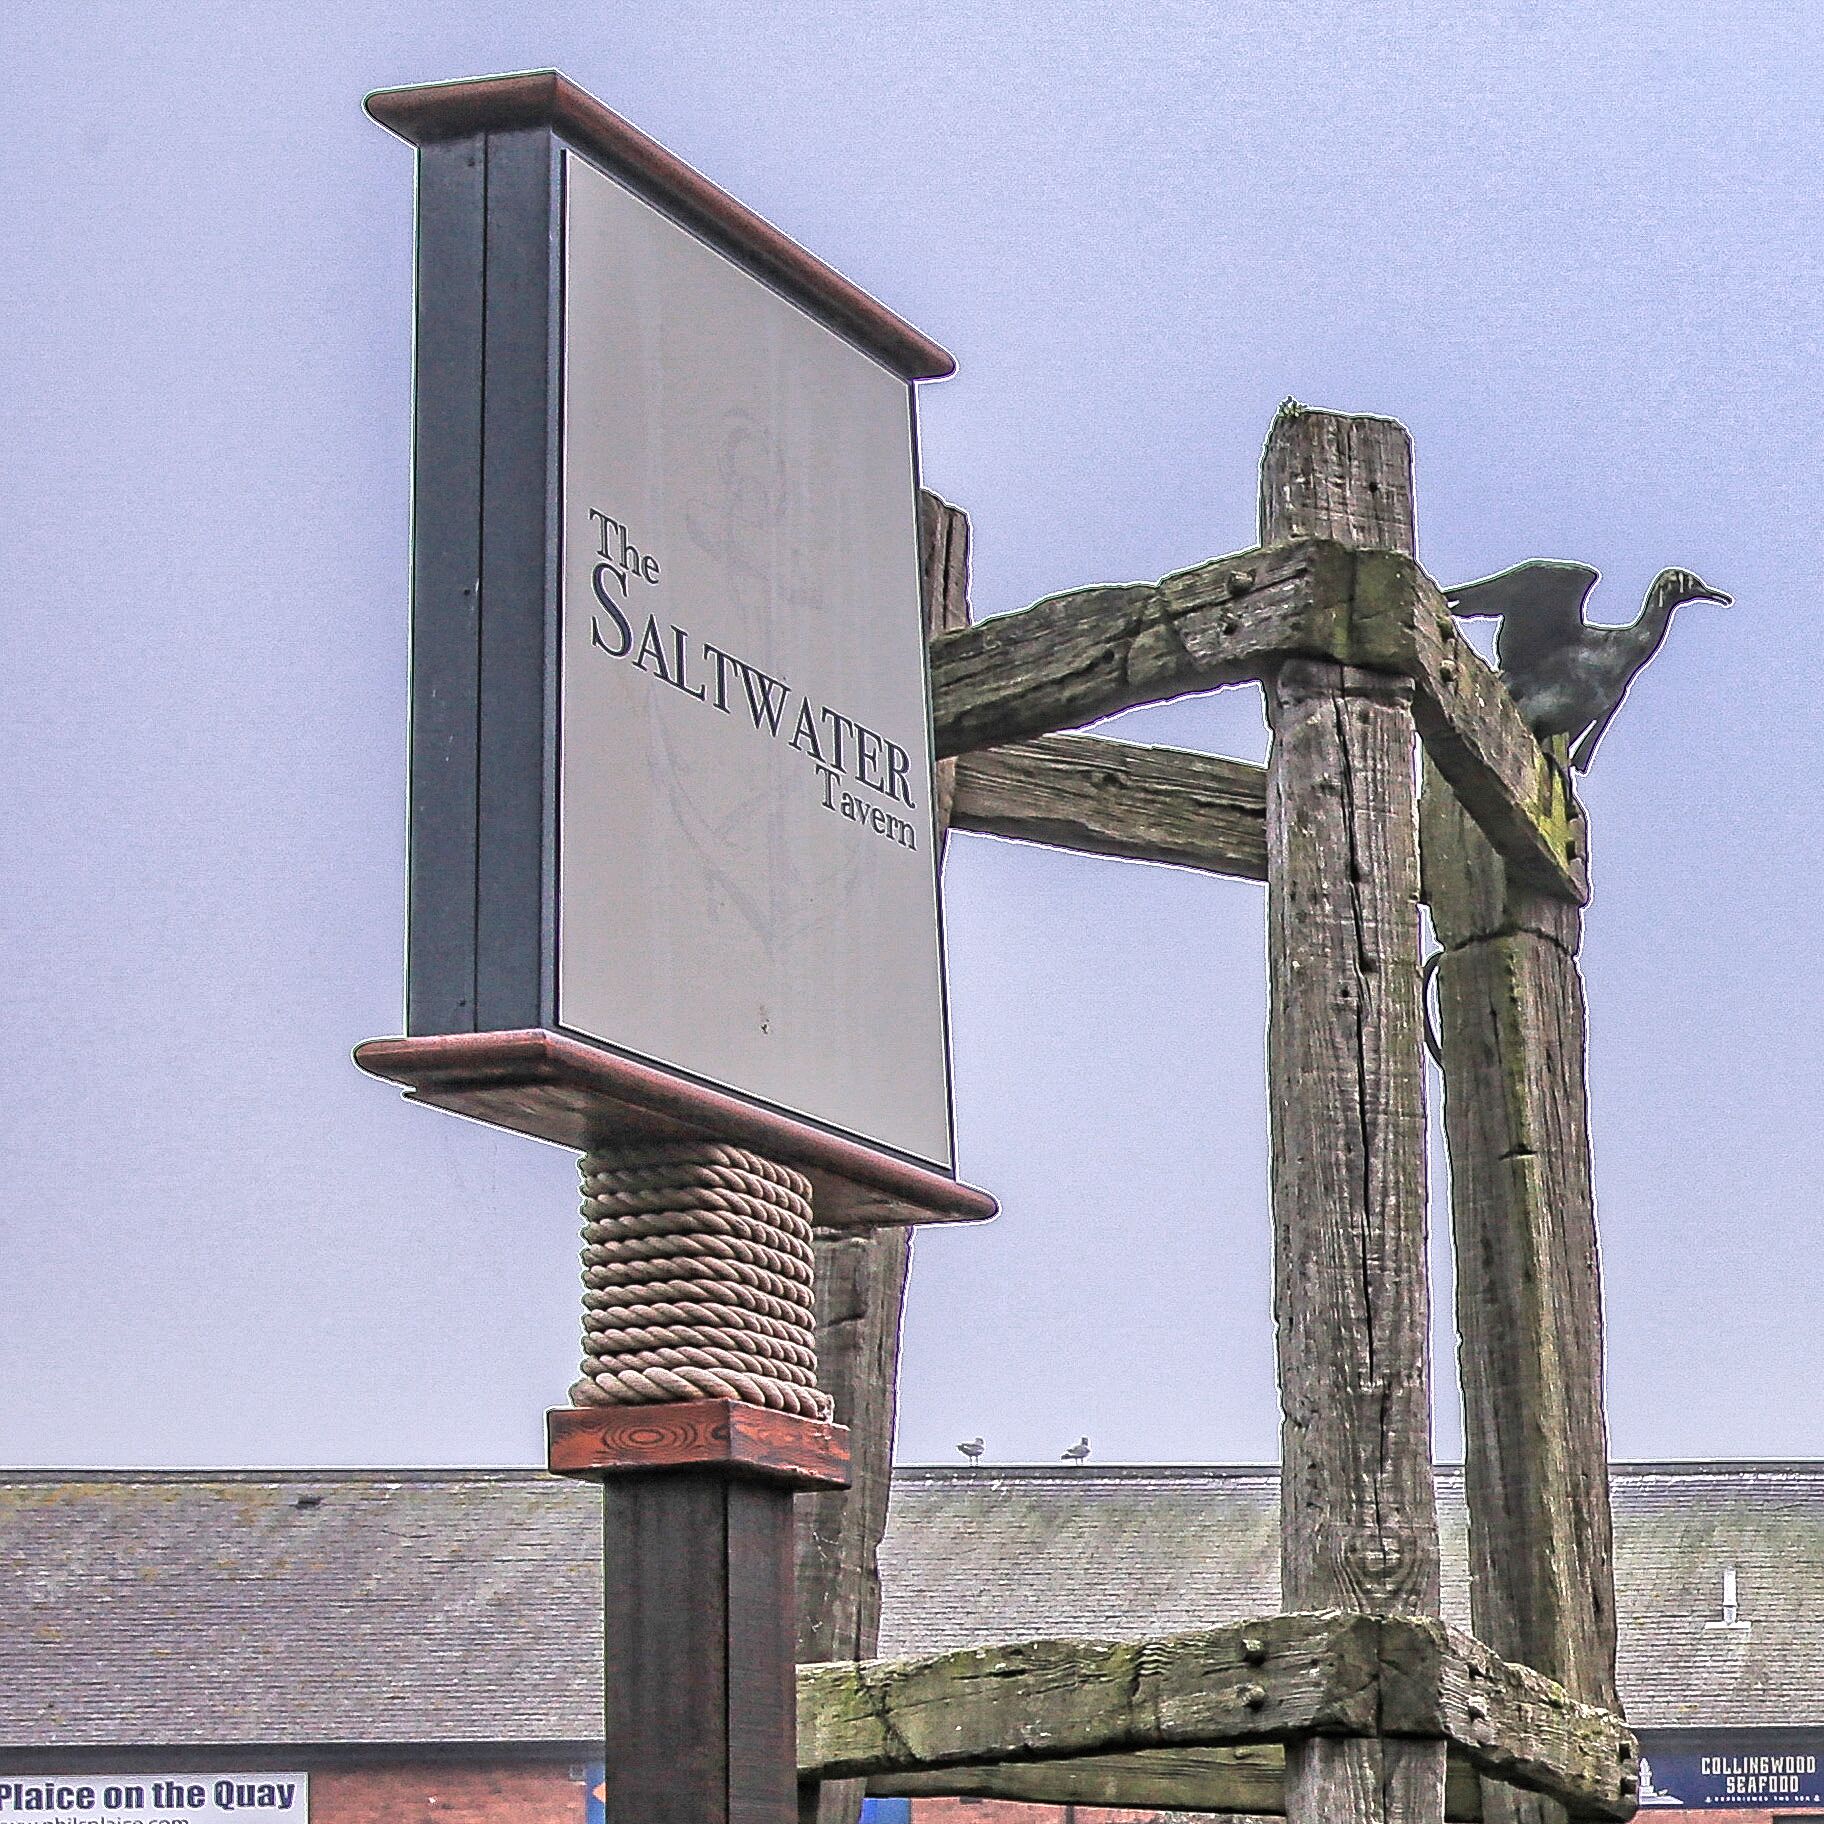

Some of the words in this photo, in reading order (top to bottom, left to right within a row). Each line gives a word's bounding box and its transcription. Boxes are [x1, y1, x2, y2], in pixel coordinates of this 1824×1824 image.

[589, 507, 660, 585] The
[591, 562, 916, 810] SALTWATER
[815, 763, 918, 852] Tavern
[1701, 1755, 1816, 1775] COLLINGWOOD
[1726, 1775, 1799, 1793] SEAFOOD
[0, 1782, 95, 1810] Plaice
[104, 1784, 144, 1810] on
[152, 1780, 206, 1810] the
[214, 1779, 296, 1811] Quay
